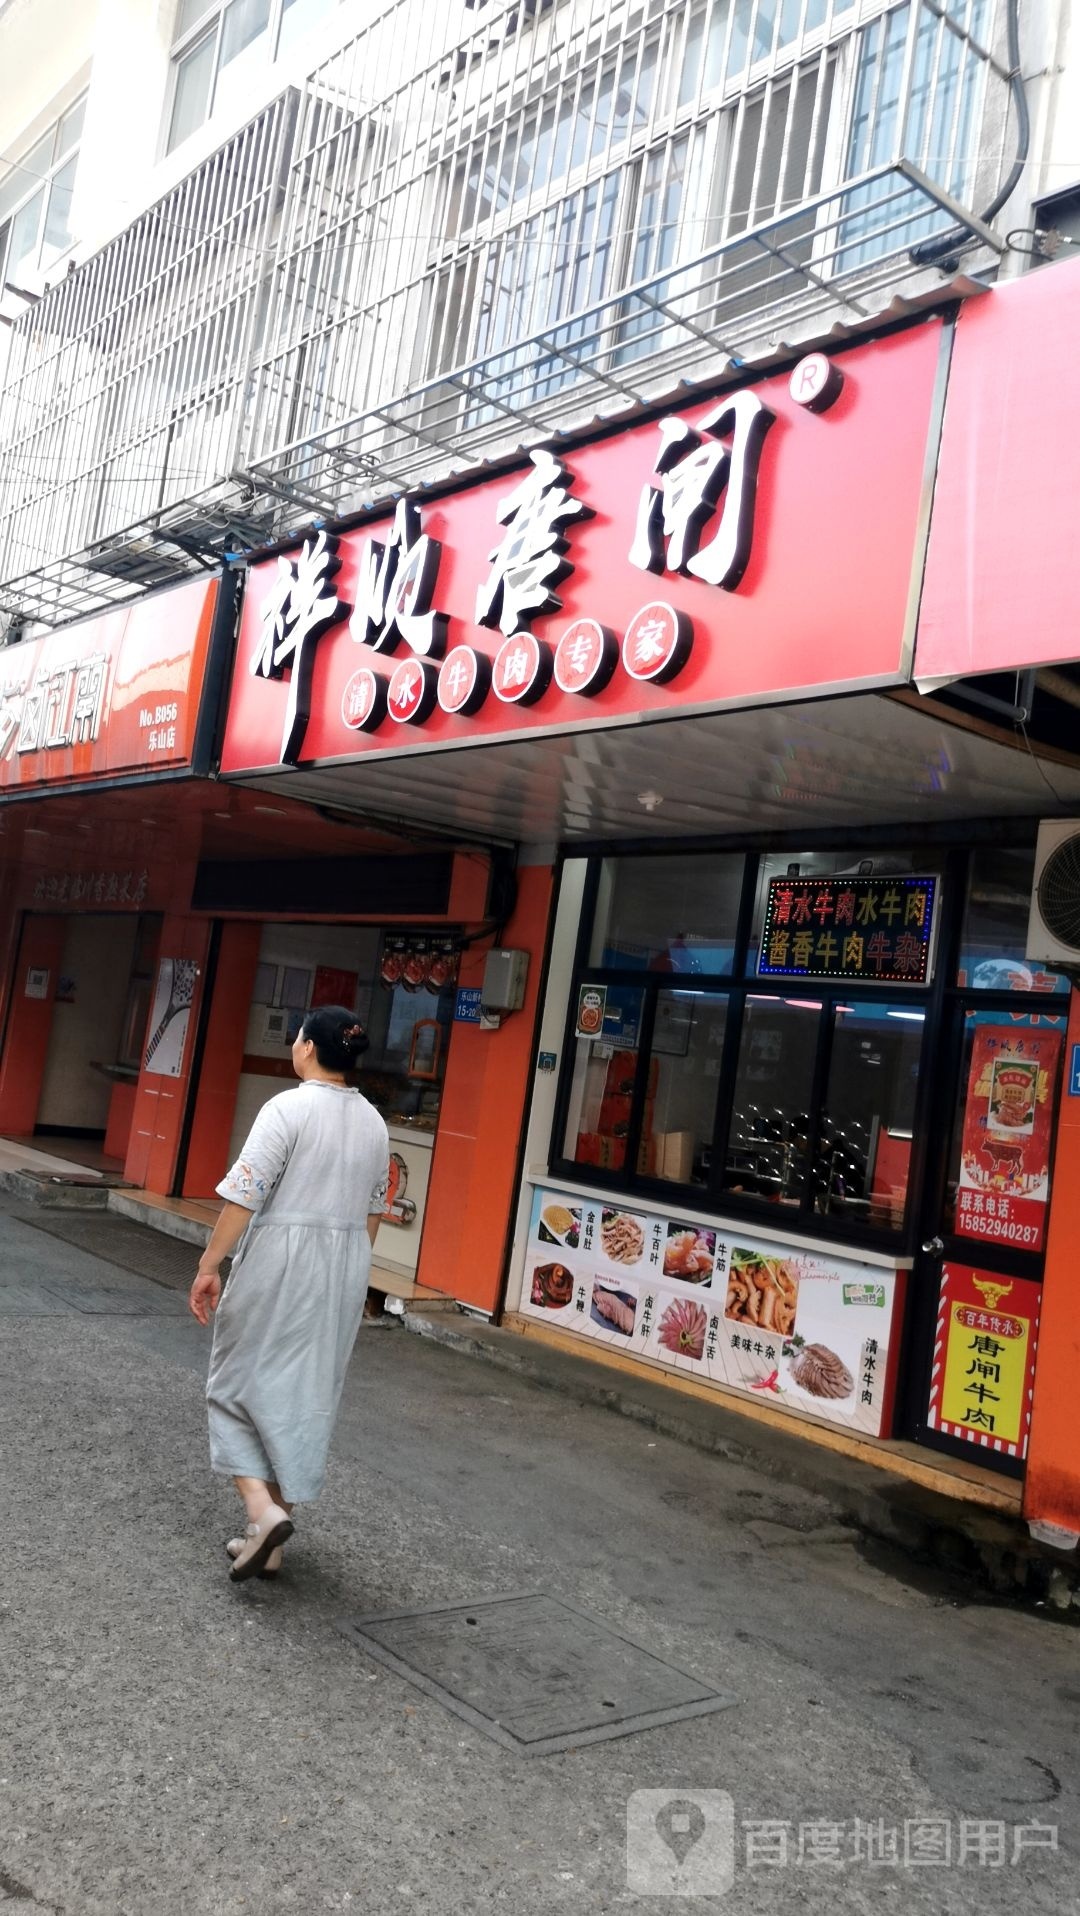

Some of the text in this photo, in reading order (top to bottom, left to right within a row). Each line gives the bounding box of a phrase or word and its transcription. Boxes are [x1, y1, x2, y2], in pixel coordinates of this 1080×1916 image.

[346, 612, 676, 716] 清水牛肉专家
[139, 703, 178, 727] No.B056
[148, 726, 177, 752] 乐山店
[772, 888, 927, 926] 清水牛肉水牛肉
[769, 929, 922, 972] 酱香牛肉牛杂
[960, 1191, 1015, 1220] 联系电话：
[583, 1211, 596, 1251] 金钱肚
[649, 1223, 662, 1266] 牛百叶
[959, 1213, 1039, 1244] 15852940287
[715, 1243, 727, 1272] 牛筋
[575, 1286, 586, 1313] 牛鞭
[640, 1296, 653, 1338] 卤牛肝
[706, 1315, 719, 1360] 卤牛舌
[965, 1310, 1014, 1336] 百年传承
[730, 1334, 776, 1361] 美味牛杂
[860, 1337, 879, 1406] 清水牛肉
[960, 1334, 1006, 1432] 唐闸牛肉
